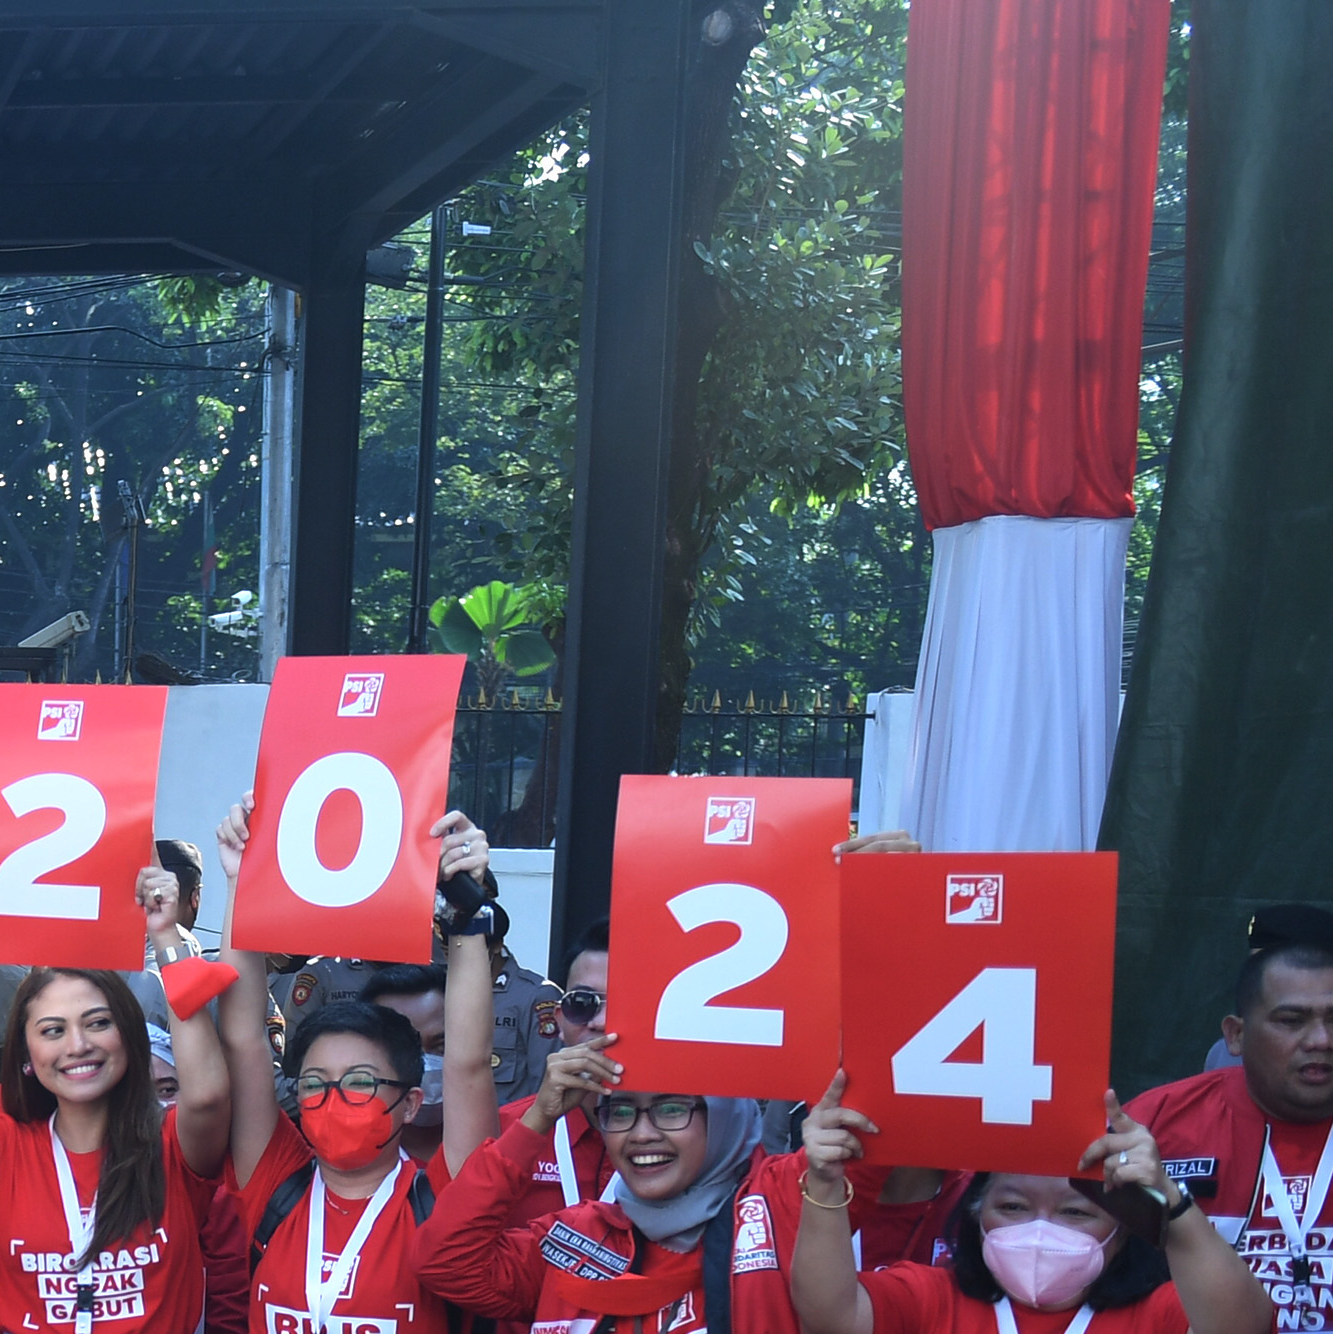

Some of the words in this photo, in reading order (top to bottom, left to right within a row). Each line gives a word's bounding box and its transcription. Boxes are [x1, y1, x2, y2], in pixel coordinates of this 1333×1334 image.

[344, 682, 364, 693] PSI
[707, 805, 732, 818] PSI
[276, 752, 404, 908] 0
[949, 884, 975, 896] PSI
[654, 882, 789, 1047] 2
[890, 967, 1053, 1126] 4
[1162, 1161, 1206, 1176] RIZAL
[1239, 1232, 1333, 1252] RBD
[21, 1243, 160, 1273] BIRORASI
[1263, 1283, 1333, 1309] GAN
